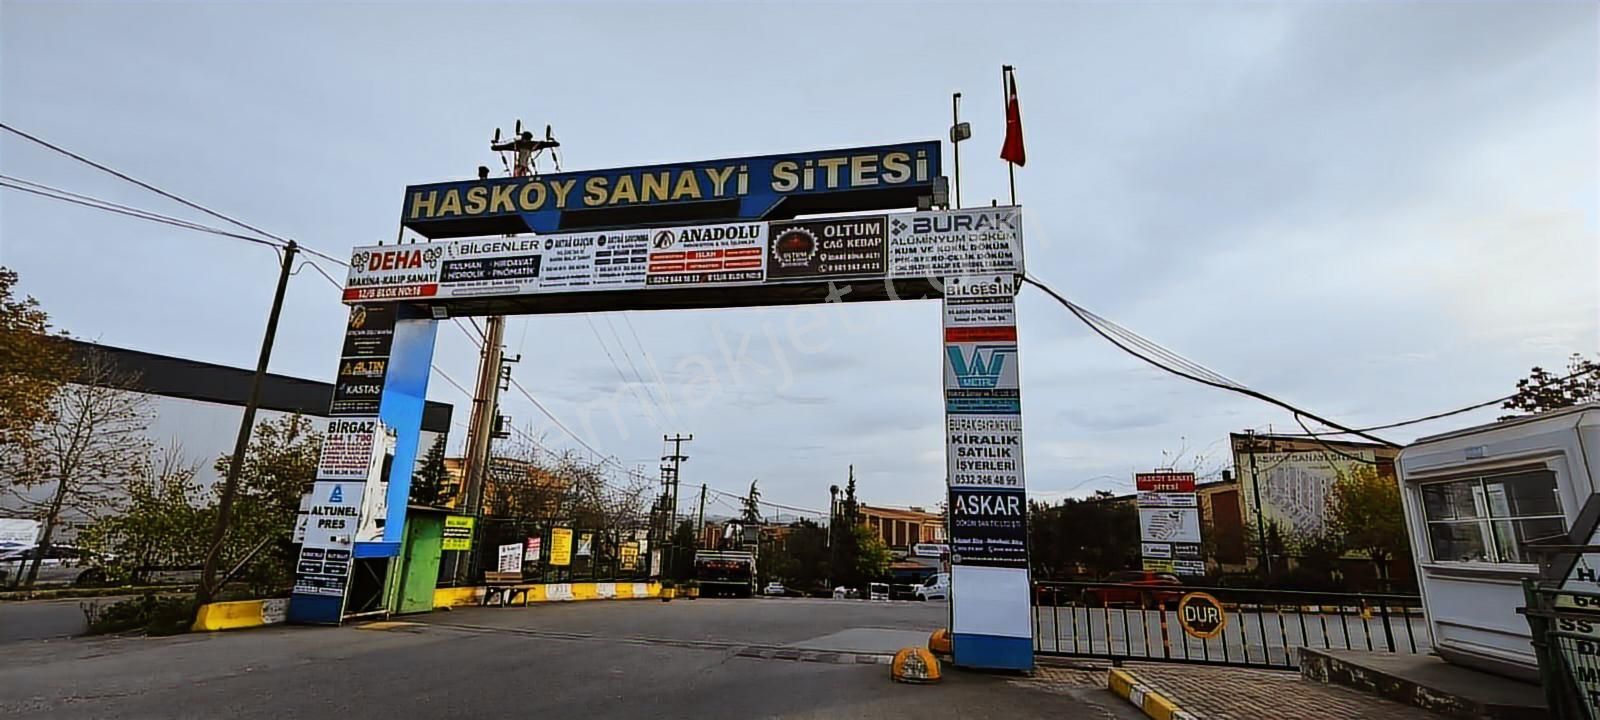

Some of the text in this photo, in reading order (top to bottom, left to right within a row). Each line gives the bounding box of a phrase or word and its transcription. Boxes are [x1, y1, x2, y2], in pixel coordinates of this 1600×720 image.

[410, 176, 577, 219] HASKÖY
[823, 222, 881, 237] OLTUM
[913, 213, 1016, 234] BURAK
[679, 225, 761, 242] ANADOLU
[460, 240, 540, 255] BİLGENLER
[847, 238, 881, 247] KEBAP
[368, 250, 422, 271] DEHA
[328, 419, 375, 433] BİRGAZ
[951, 433, 1018, 445] KİRALIK
[957, 447, 1011, 457] SATILIK
[956, 458, 1016, 471] İŞYERLERİ
[955, 474, 975, 484] 0532
[1006, 475, 1017, 485] 99
[311, 505, 358, 516] ALTUNEL
[954, 494, 1021, 516] ASKAR
[318, 519, 345, 529] PRES
[1185, 605, 1219, 624] DUR
